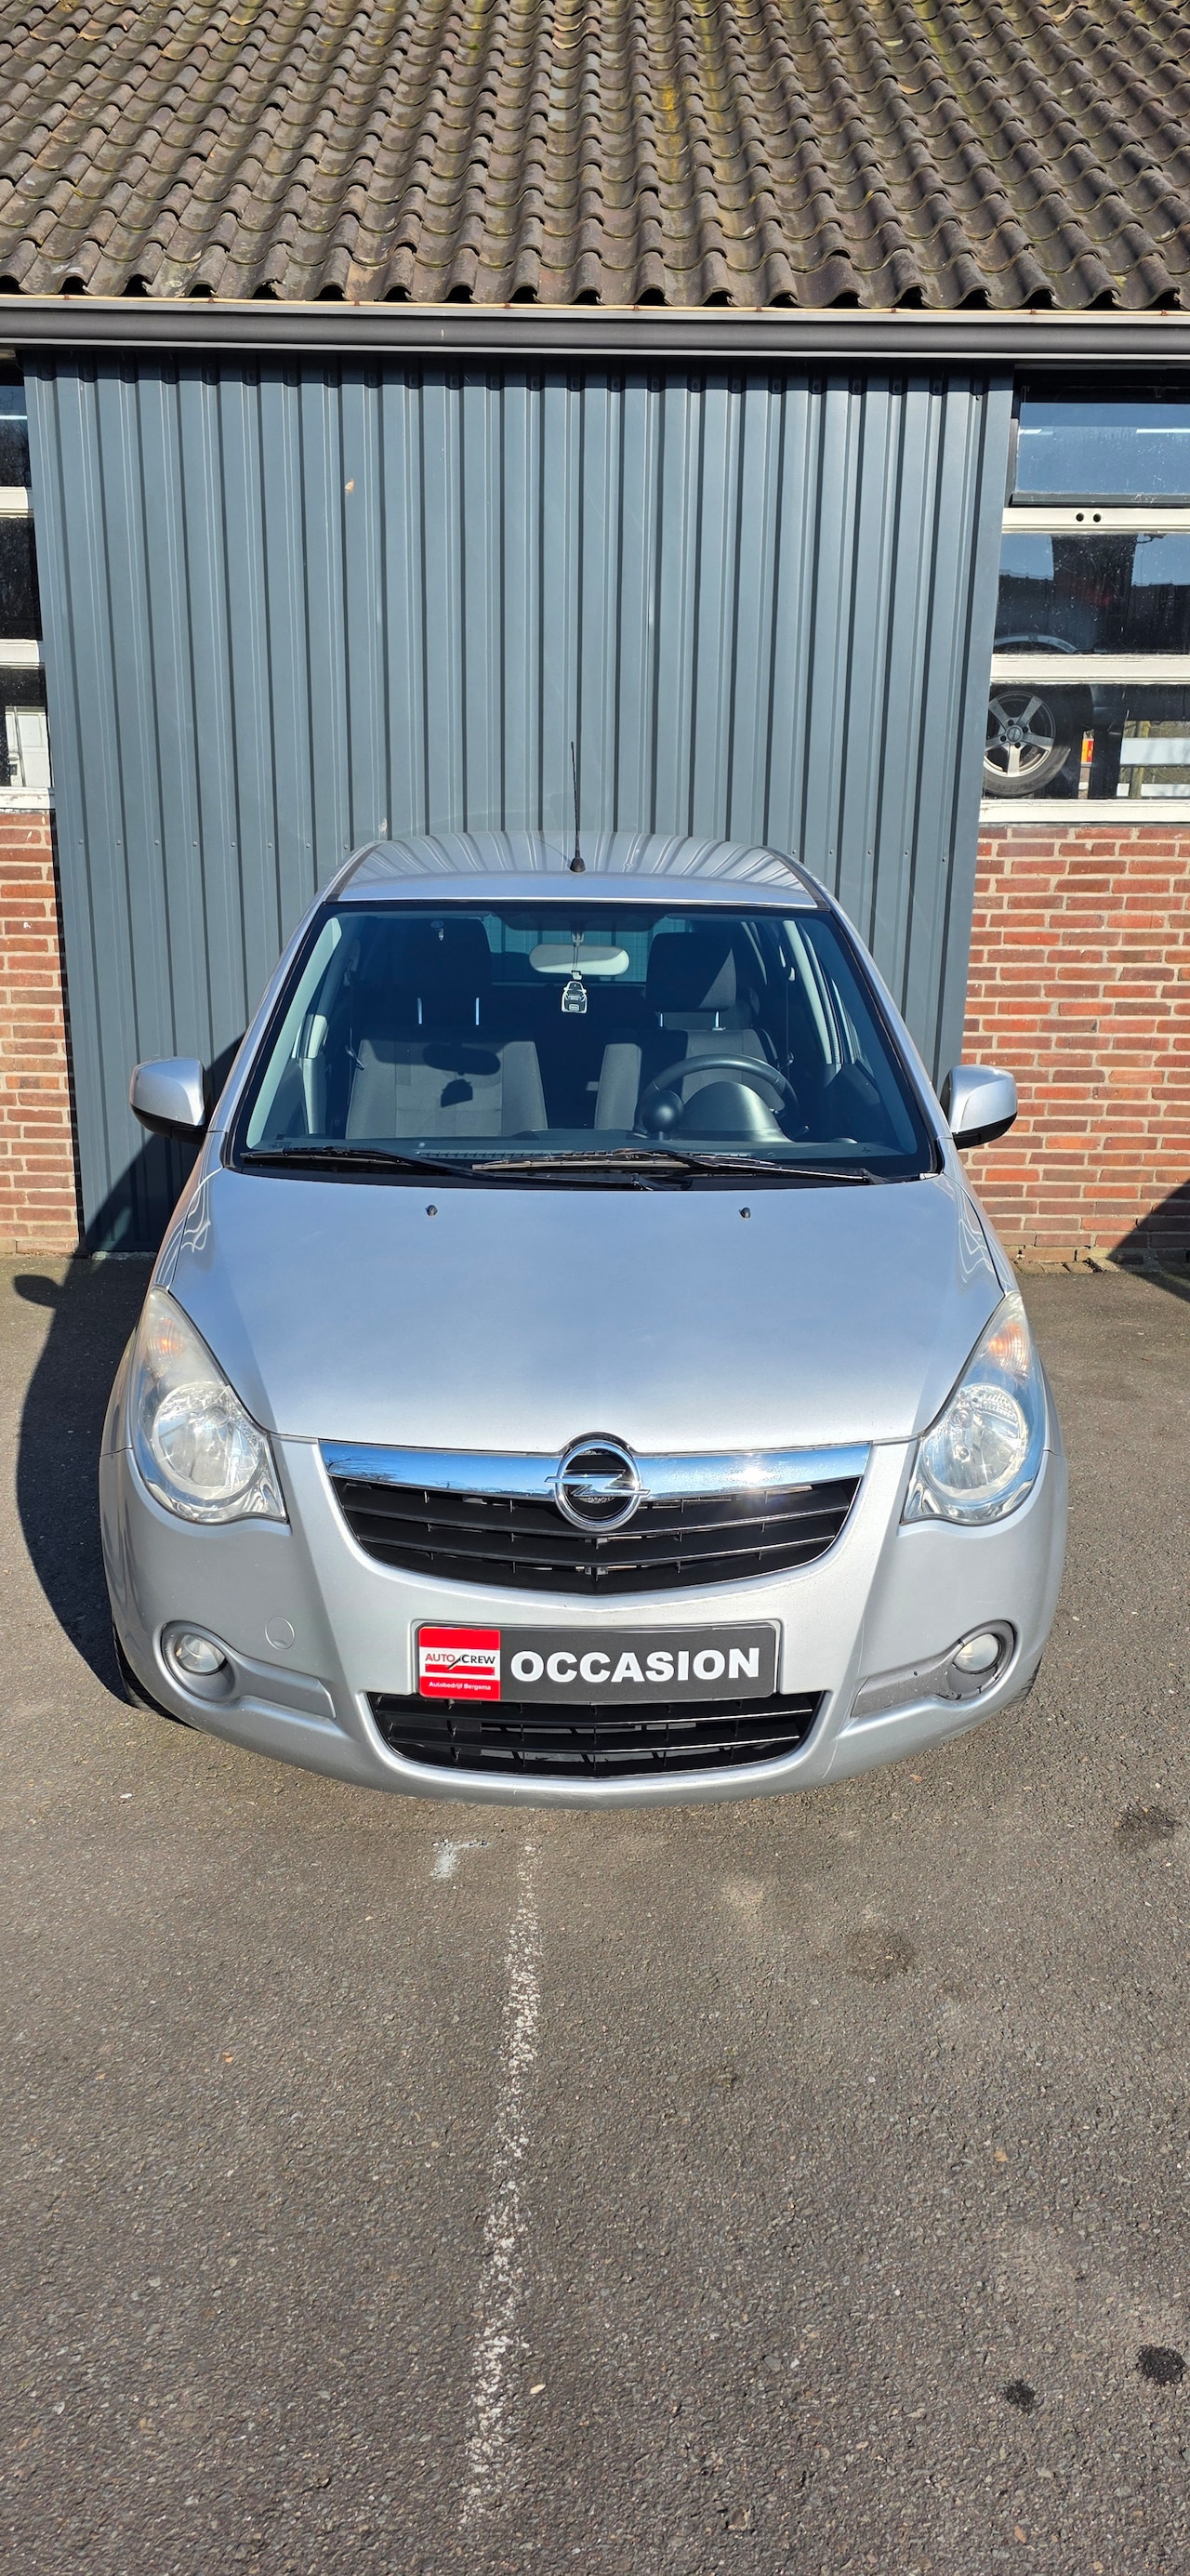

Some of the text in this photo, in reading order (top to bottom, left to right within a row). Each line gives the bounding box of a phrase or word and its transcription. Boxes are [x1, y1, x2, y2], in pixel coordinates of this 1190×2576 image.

[425, 1653, 496, 1664] AUTO CREW
[510, 1647, 760, 1683] OCCASION
[429, 1681, 463, 1689] Autobedrijf
